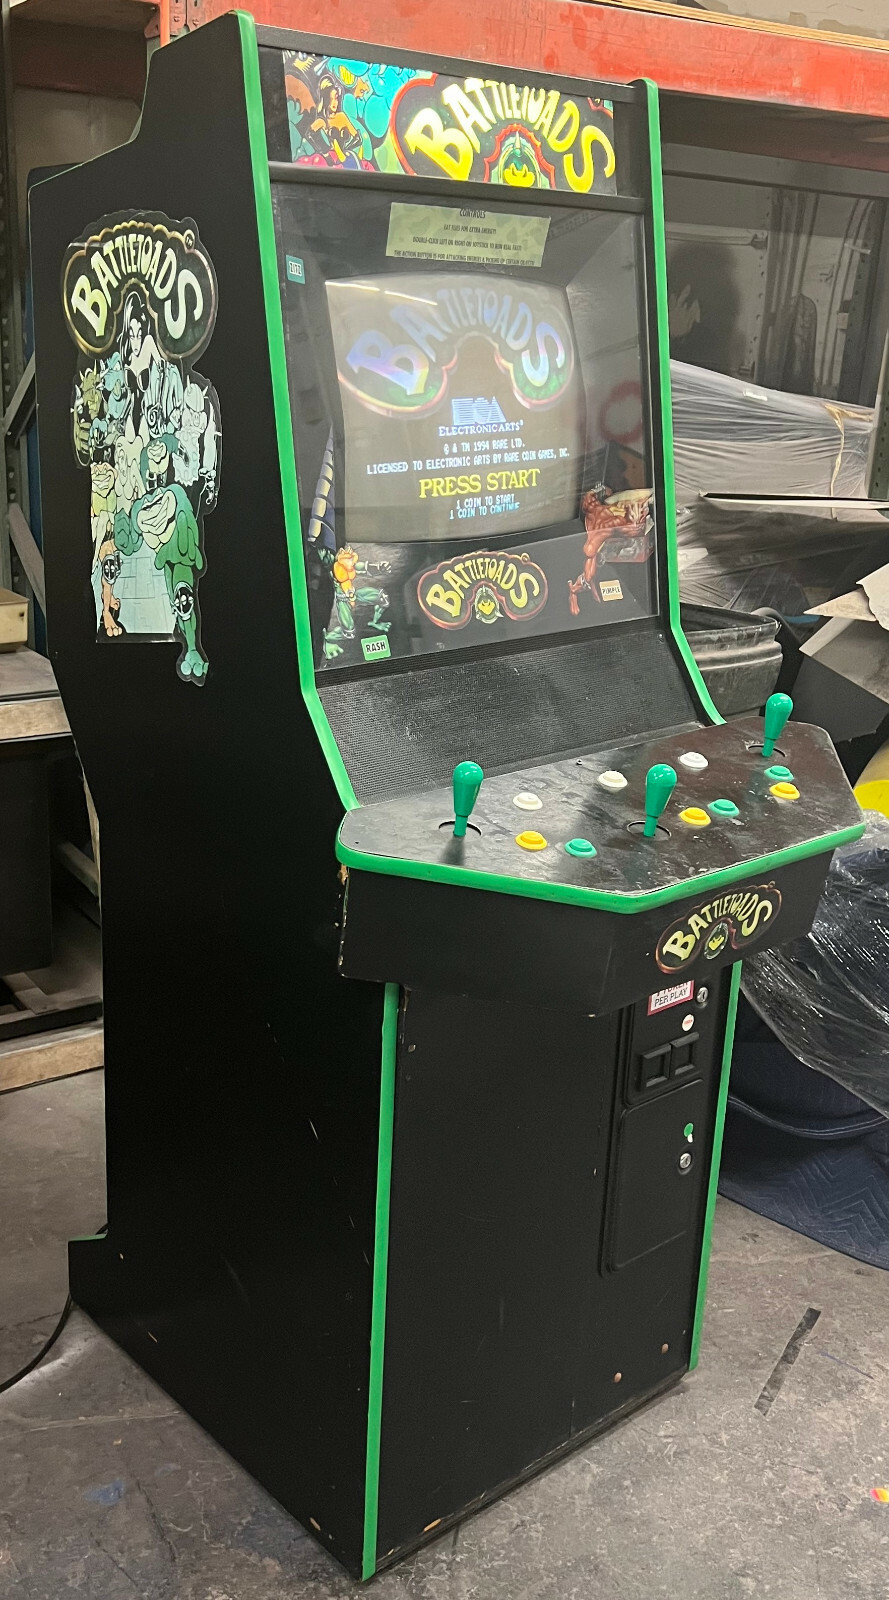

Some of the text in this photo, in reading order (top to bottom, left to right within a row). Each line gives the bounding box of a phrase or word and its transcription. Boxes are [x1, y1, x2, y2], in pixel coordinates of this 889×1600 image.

[404, 77, 616, 193] BATTLETOADS
[70, 233, 204, 340] BATTLETOADS
[345, 287, 566, 396] BATTLETOADS
[438, 424, 498, 437] ELECTRONIC
[461, 442, 471, 452] TM
[473, 440, 489, 452] 1994
[492, 439, 508, 450] RARE
[511, 437, 525, 449] LTD.
[366, 447, 570, 475] LICENSED TO ELECTRONIC ARTS BY RARE COIN GAMES, INC.
[419, 468, 541, 498] PRESS START
[449, 502, 521, 519] 1 COIN TO CONTINUE
[456, 493, 515, 509] 1 COIN TO START
[426, 556, 541, 617] BATTLETOADS
[365, 641, 386, 653] RASH
[662, 892, 773, 960] BATTLETOADS
[654, 995, 669, 1008] PER
[670, 987, 688, 1002] PLAY
